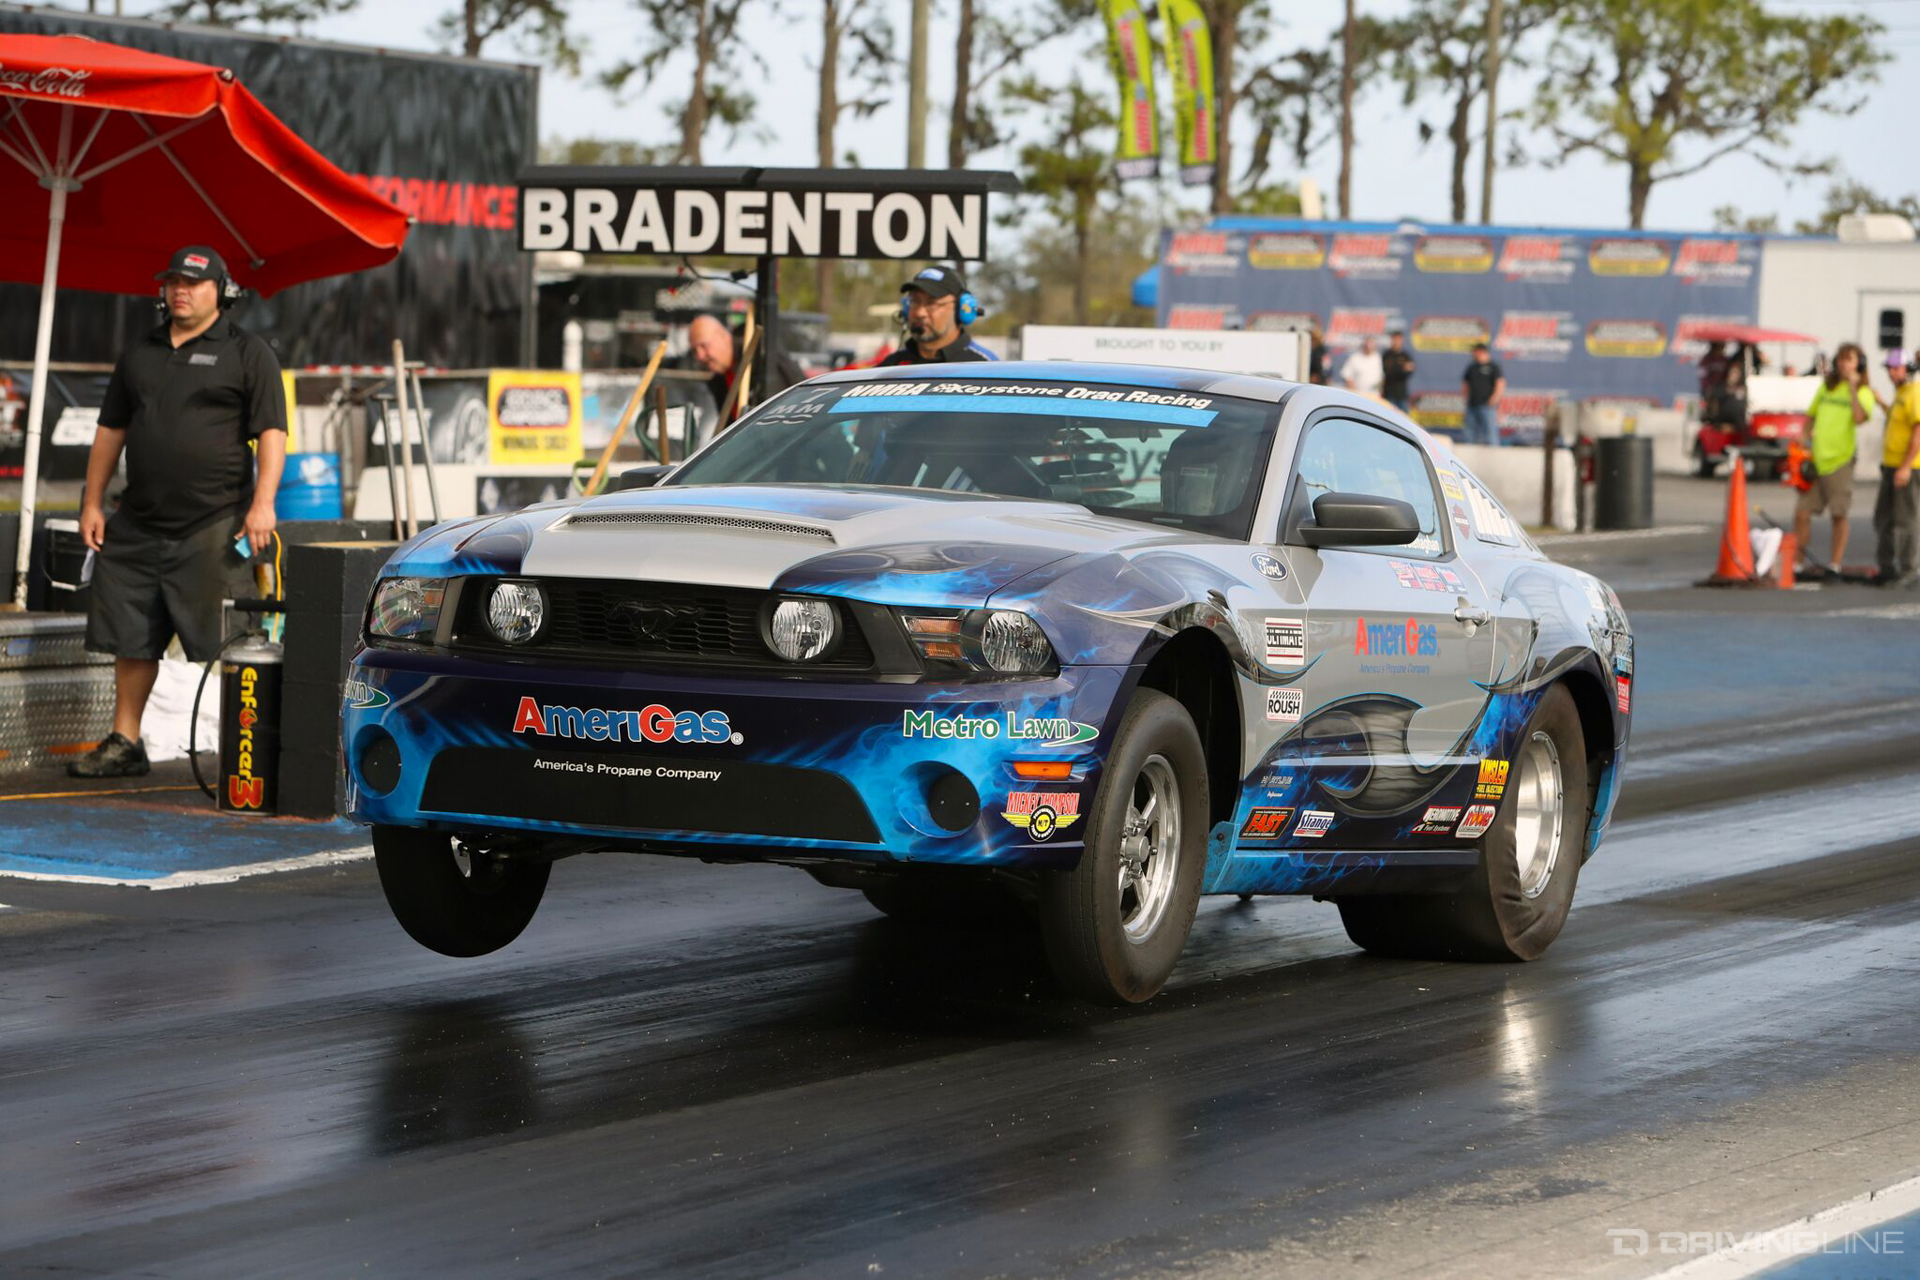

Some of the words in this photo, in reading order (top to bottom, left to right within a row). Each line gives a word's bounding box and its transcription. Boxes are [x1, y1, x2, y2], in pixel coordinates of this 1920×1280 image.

[523, 188, 981, 258] BRADENTON
[1095, 338, 1154, 350] BROUGHT
[1159, 339, 1176, 350] TO
[1180, 340, 1206, 351] YOU
[1209, 341, 1223, 352] BY
[841, 383, 931, 398] NMRA
[946, 383, 1063, 396] Keystone
[1064, 387, 1125, 402] Drag
[1124, 390, 1213, 410] Racing
[1255, 554, 1284, 577] Ford
[1354, 616, 1437, 656] AmeriGas
[1268, 699, 1300, 714] ROUSH
[903, 709, 999, 739] Metro
[1007, 710, 1071, 740] Lawn
[533, 758, 594, 773] America's
[598, 763, 652, 778] Propane
[656, 767, 721, 781] Company
[1478, 758, 1509, 785] KINSLER
[1006, 792, 1039, 812] MICKEY
[1039, 792, 1080, 814] THOMPSON
[1246, 814, 1287, 833] FAST
[1299, 812, 1333, 830] Strange
